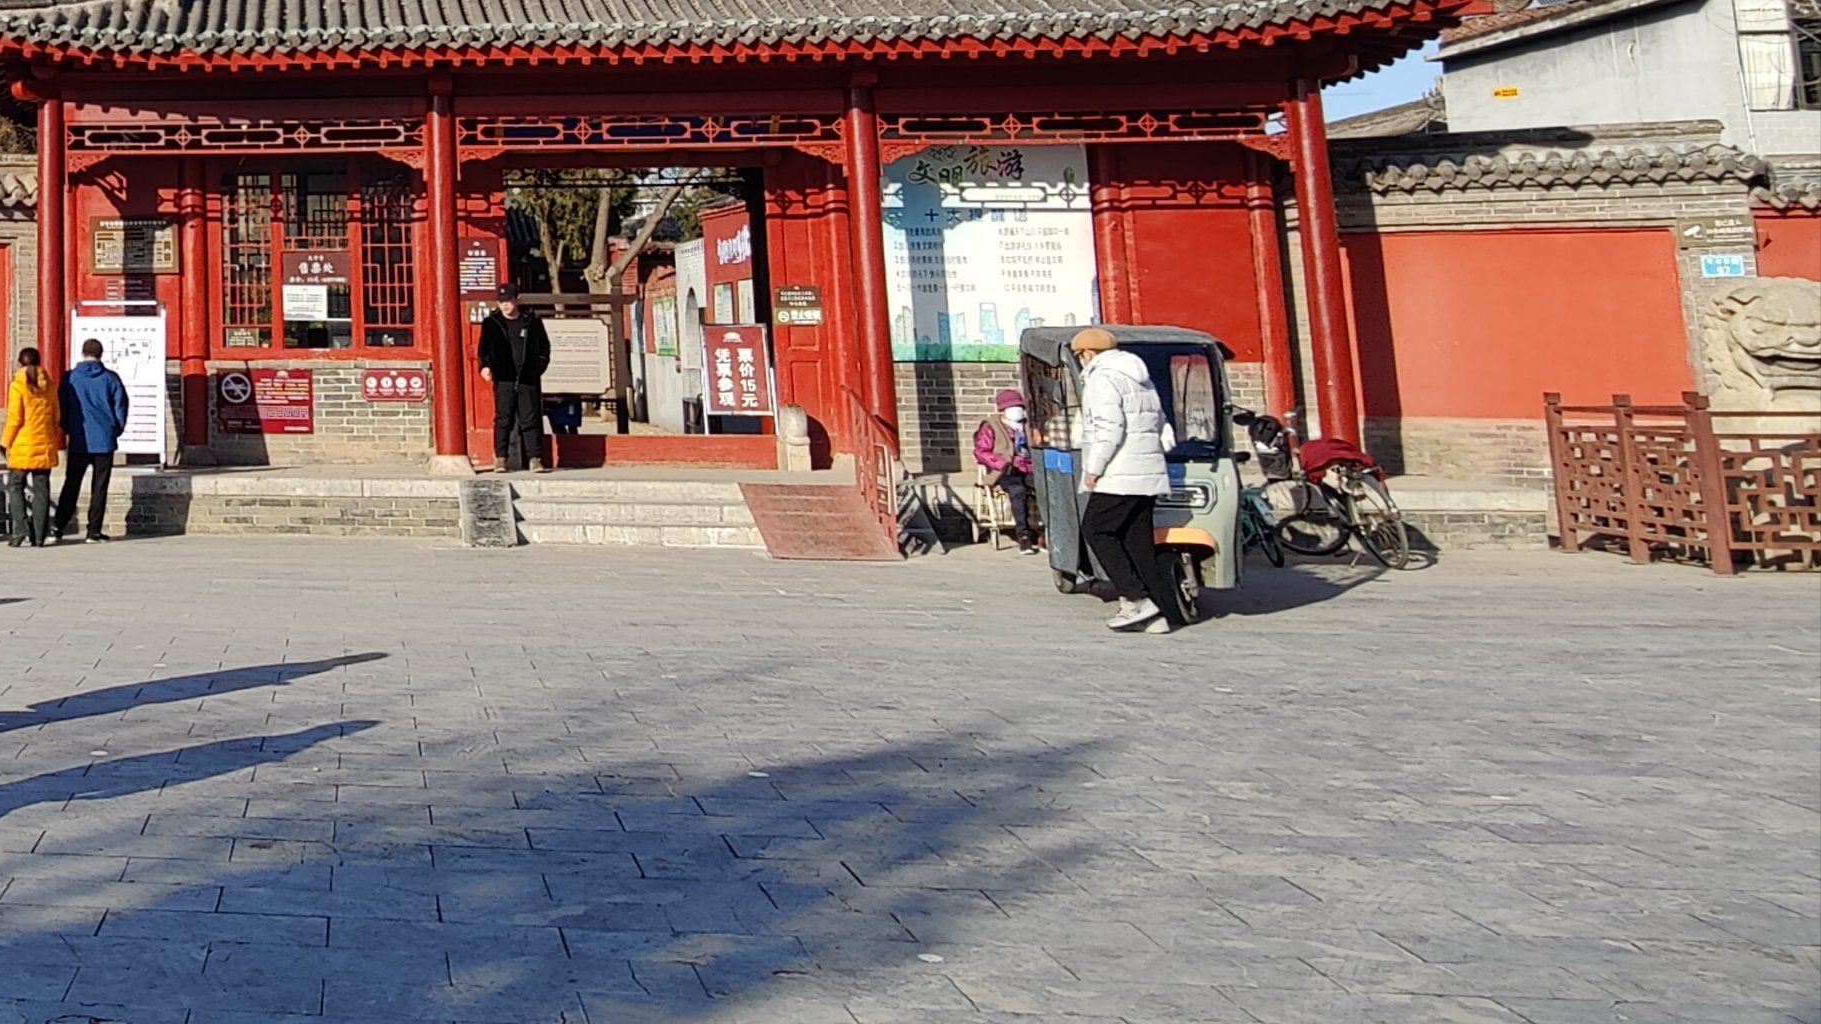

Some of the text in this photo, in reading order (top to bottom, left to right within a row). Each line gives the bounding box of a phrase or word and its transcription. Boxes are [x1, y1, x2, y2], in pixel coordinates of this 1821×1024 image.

[908, 146, 1024, 188] 文明旅游
[714, 348, 736, 407] 凭票参观
[737, 348, 758, 408] 票价15元
